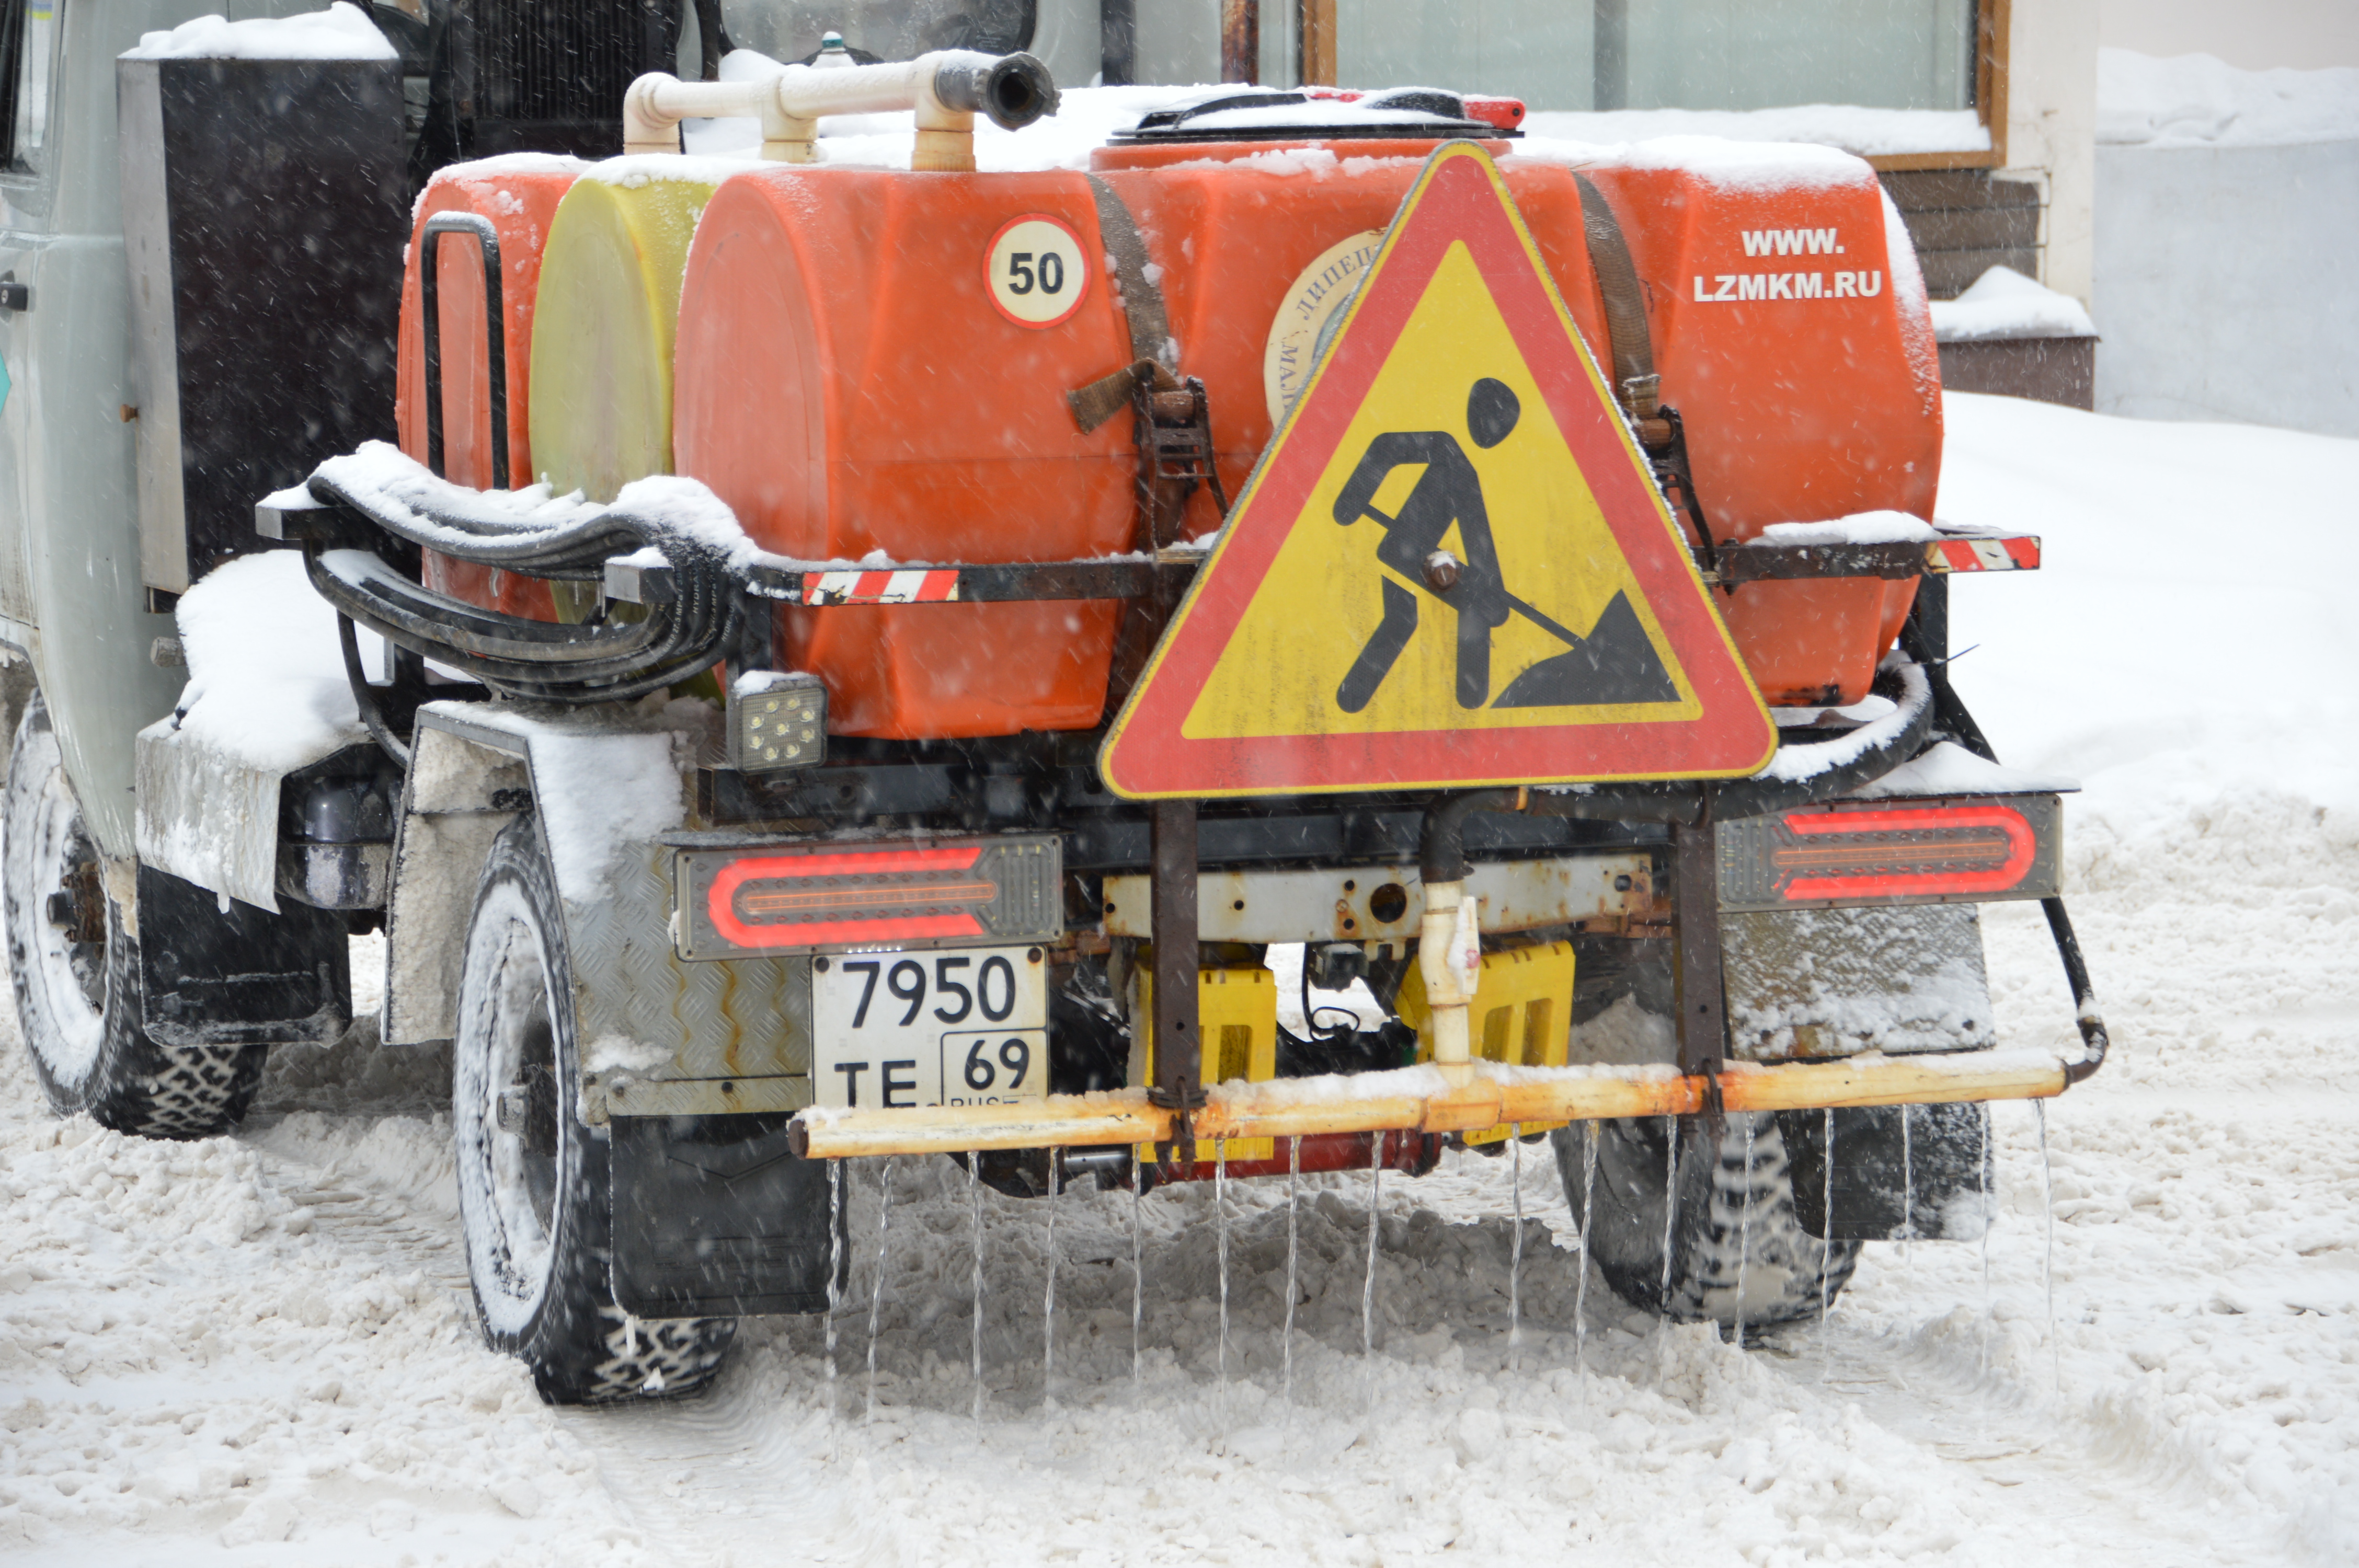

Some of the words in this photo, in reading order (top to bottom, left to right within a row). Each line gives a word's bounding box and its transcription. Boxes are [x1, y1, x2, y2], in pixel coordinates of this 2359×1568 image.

[1741, 227, 1845, 257] WWW.
[1007, 251, 1064, 295] 50
[1295, 244, 1379, 321] ЛИПЕЦ
[1693, 270, 1882, 303] LZMKM.RU
[843, 955, 1016, 1029] 7950
[964, 1037, 1030, 1091] 69
